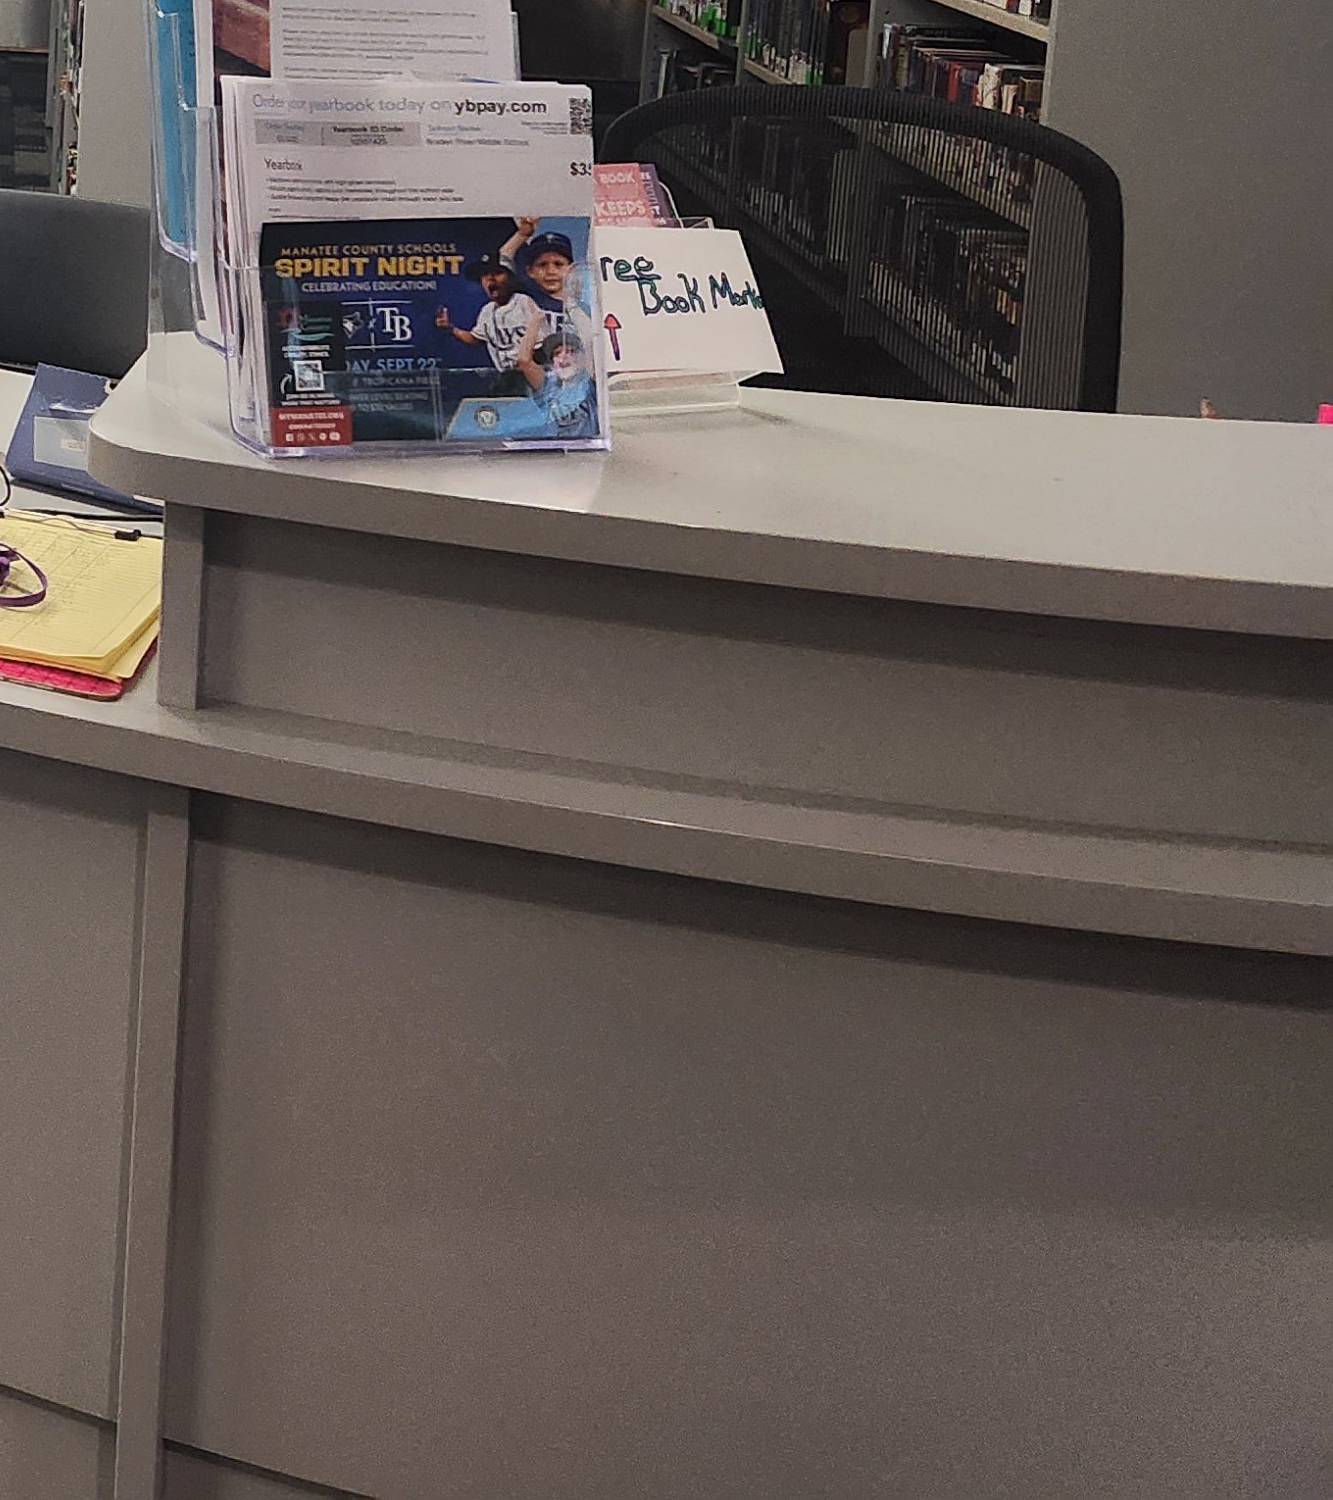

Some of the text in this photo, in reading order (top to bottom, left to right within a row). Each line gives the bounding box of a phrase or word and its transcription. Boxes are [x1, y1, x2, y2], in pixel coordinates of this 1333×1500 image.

[308, 97, 374, 113] yearbook
[377, 97, 425, 114] today
[430, 100, 453, 110] on
[454, 99, 547, 116] ybpay.com
[598, 171, 636, 184] BOOK
[594, 200, 647, 217] KEEPS
[280, 243, 457, 257] MANATEE COUNTY SCHOOLS
[274, 255, 465, 278] SPIRIT NIGHT
[600, 256, 662, 283] ree
[301, 280, 437, 293] CELEBRATING EDUCATION!
[637, 272, 706, 316] Book
[376, 307, 413, 342] TB
[377, 358, 415, 372] SEPT
